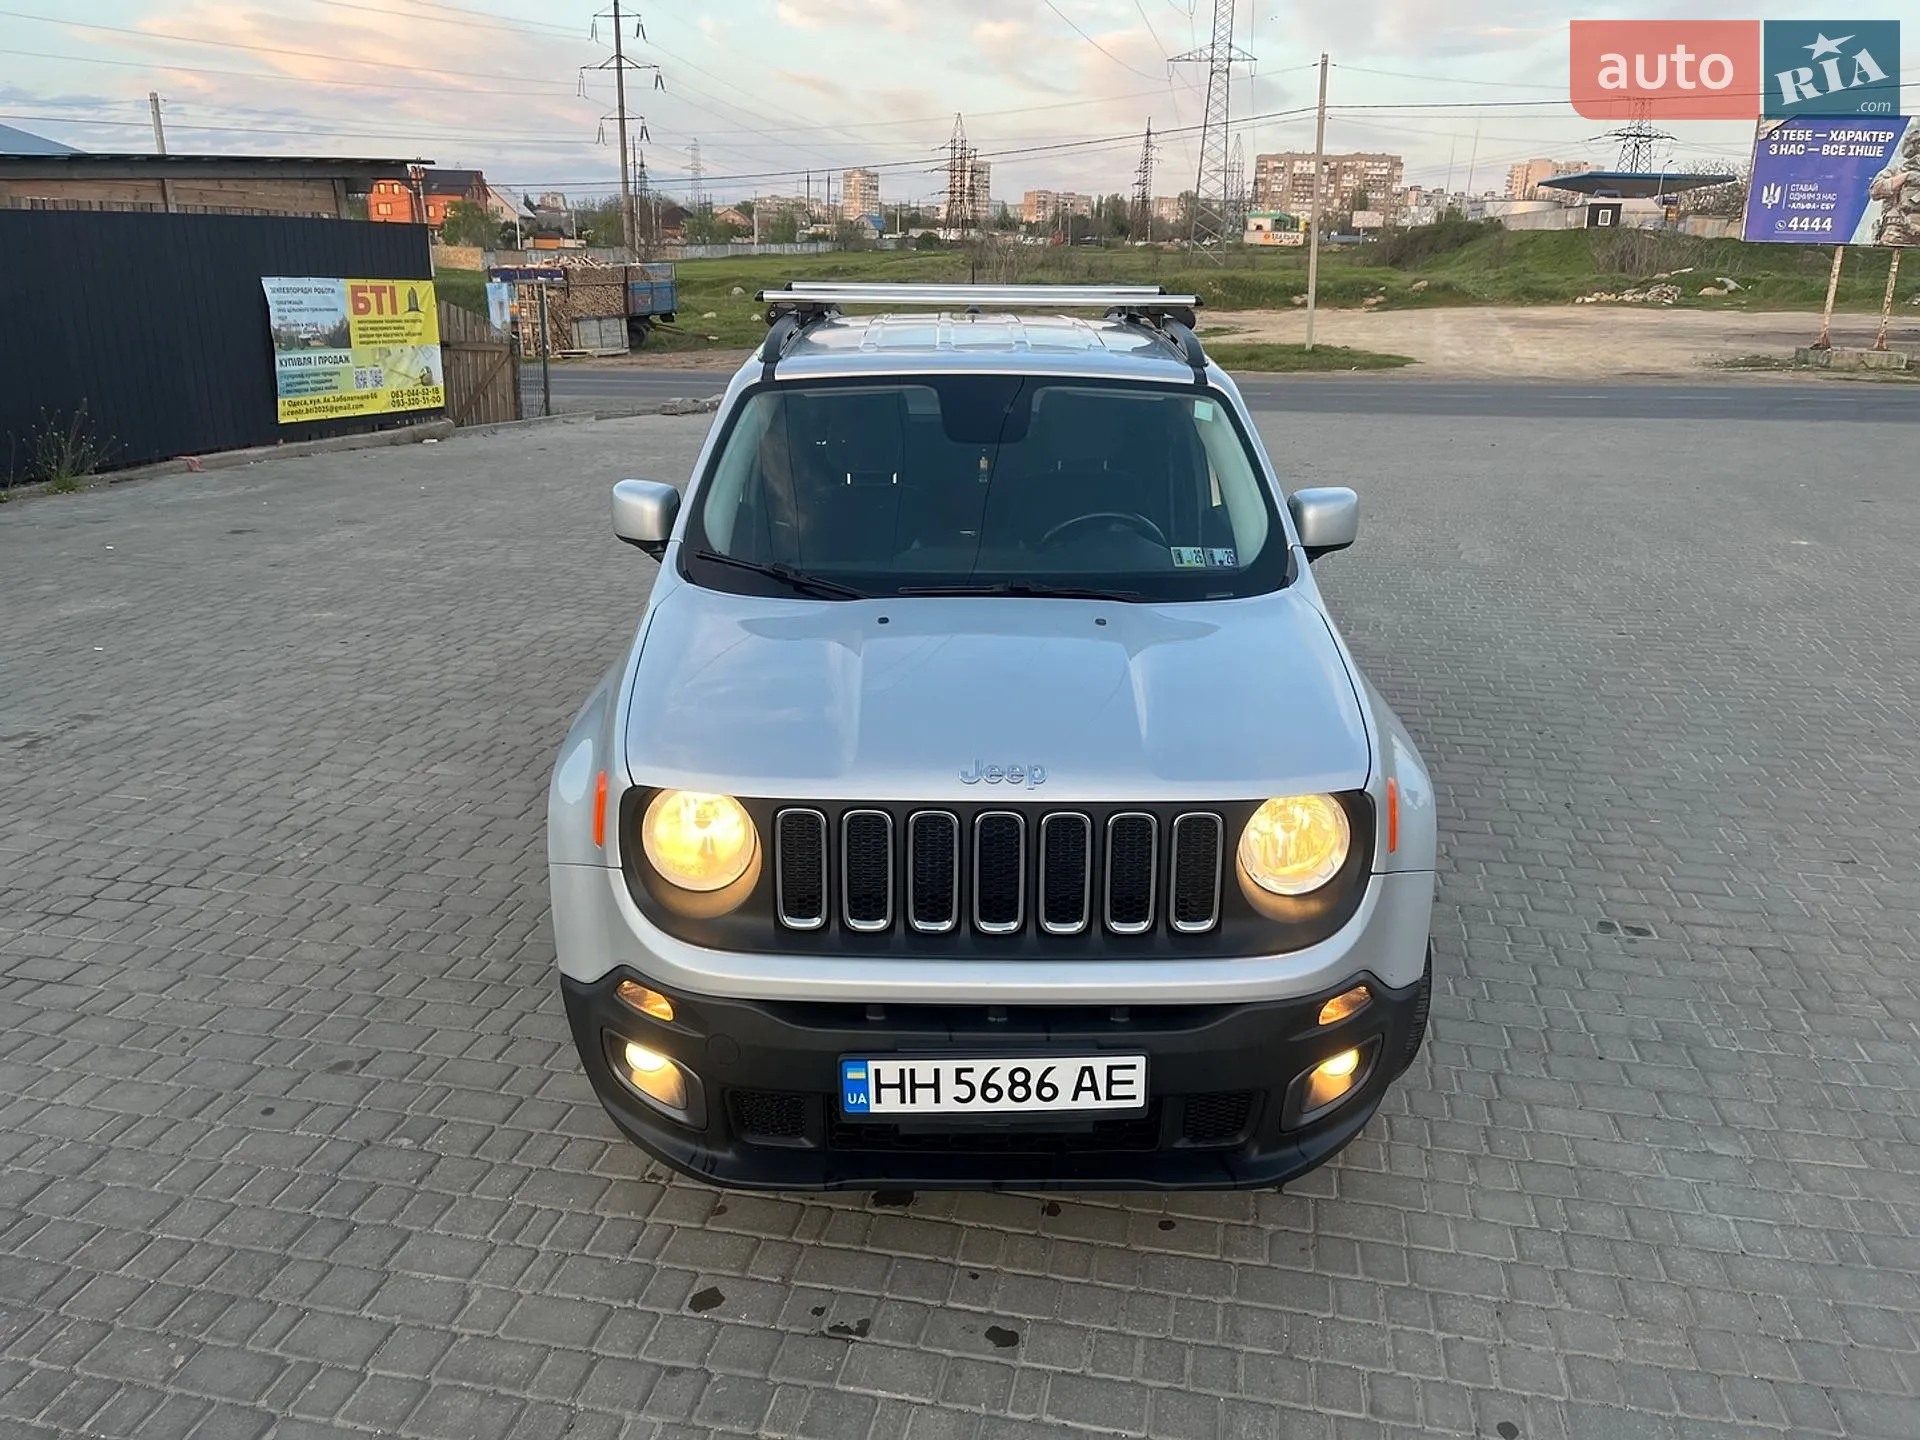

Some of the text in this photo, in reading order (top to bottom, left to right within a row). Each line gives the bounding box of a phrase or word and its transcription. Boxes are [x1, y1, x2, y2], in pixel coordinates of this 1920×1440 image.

[1781, 130, 1813, 141] ТЕБЕ
[1829, 130, 1895, 142] ХАРАКТЕР
[1778, 144, 1805, 155] НАС
[1821, 145, 1847, 156] ВСЕ
[1847, 145, 1885, 157] ІНШЕ
[1822, 193, 1837, 201] НАС
[1788, 217, 1832, 231] 4444
[350, 284, 398, 316] БТІ
[317, 354, 351, 365] ПРОДАЖ
[958, 759, 1048, 790] Jeep
[874, 1064, 1138, 1105] HH 5686 AE
[847, 1092, 867, 1104] UA
